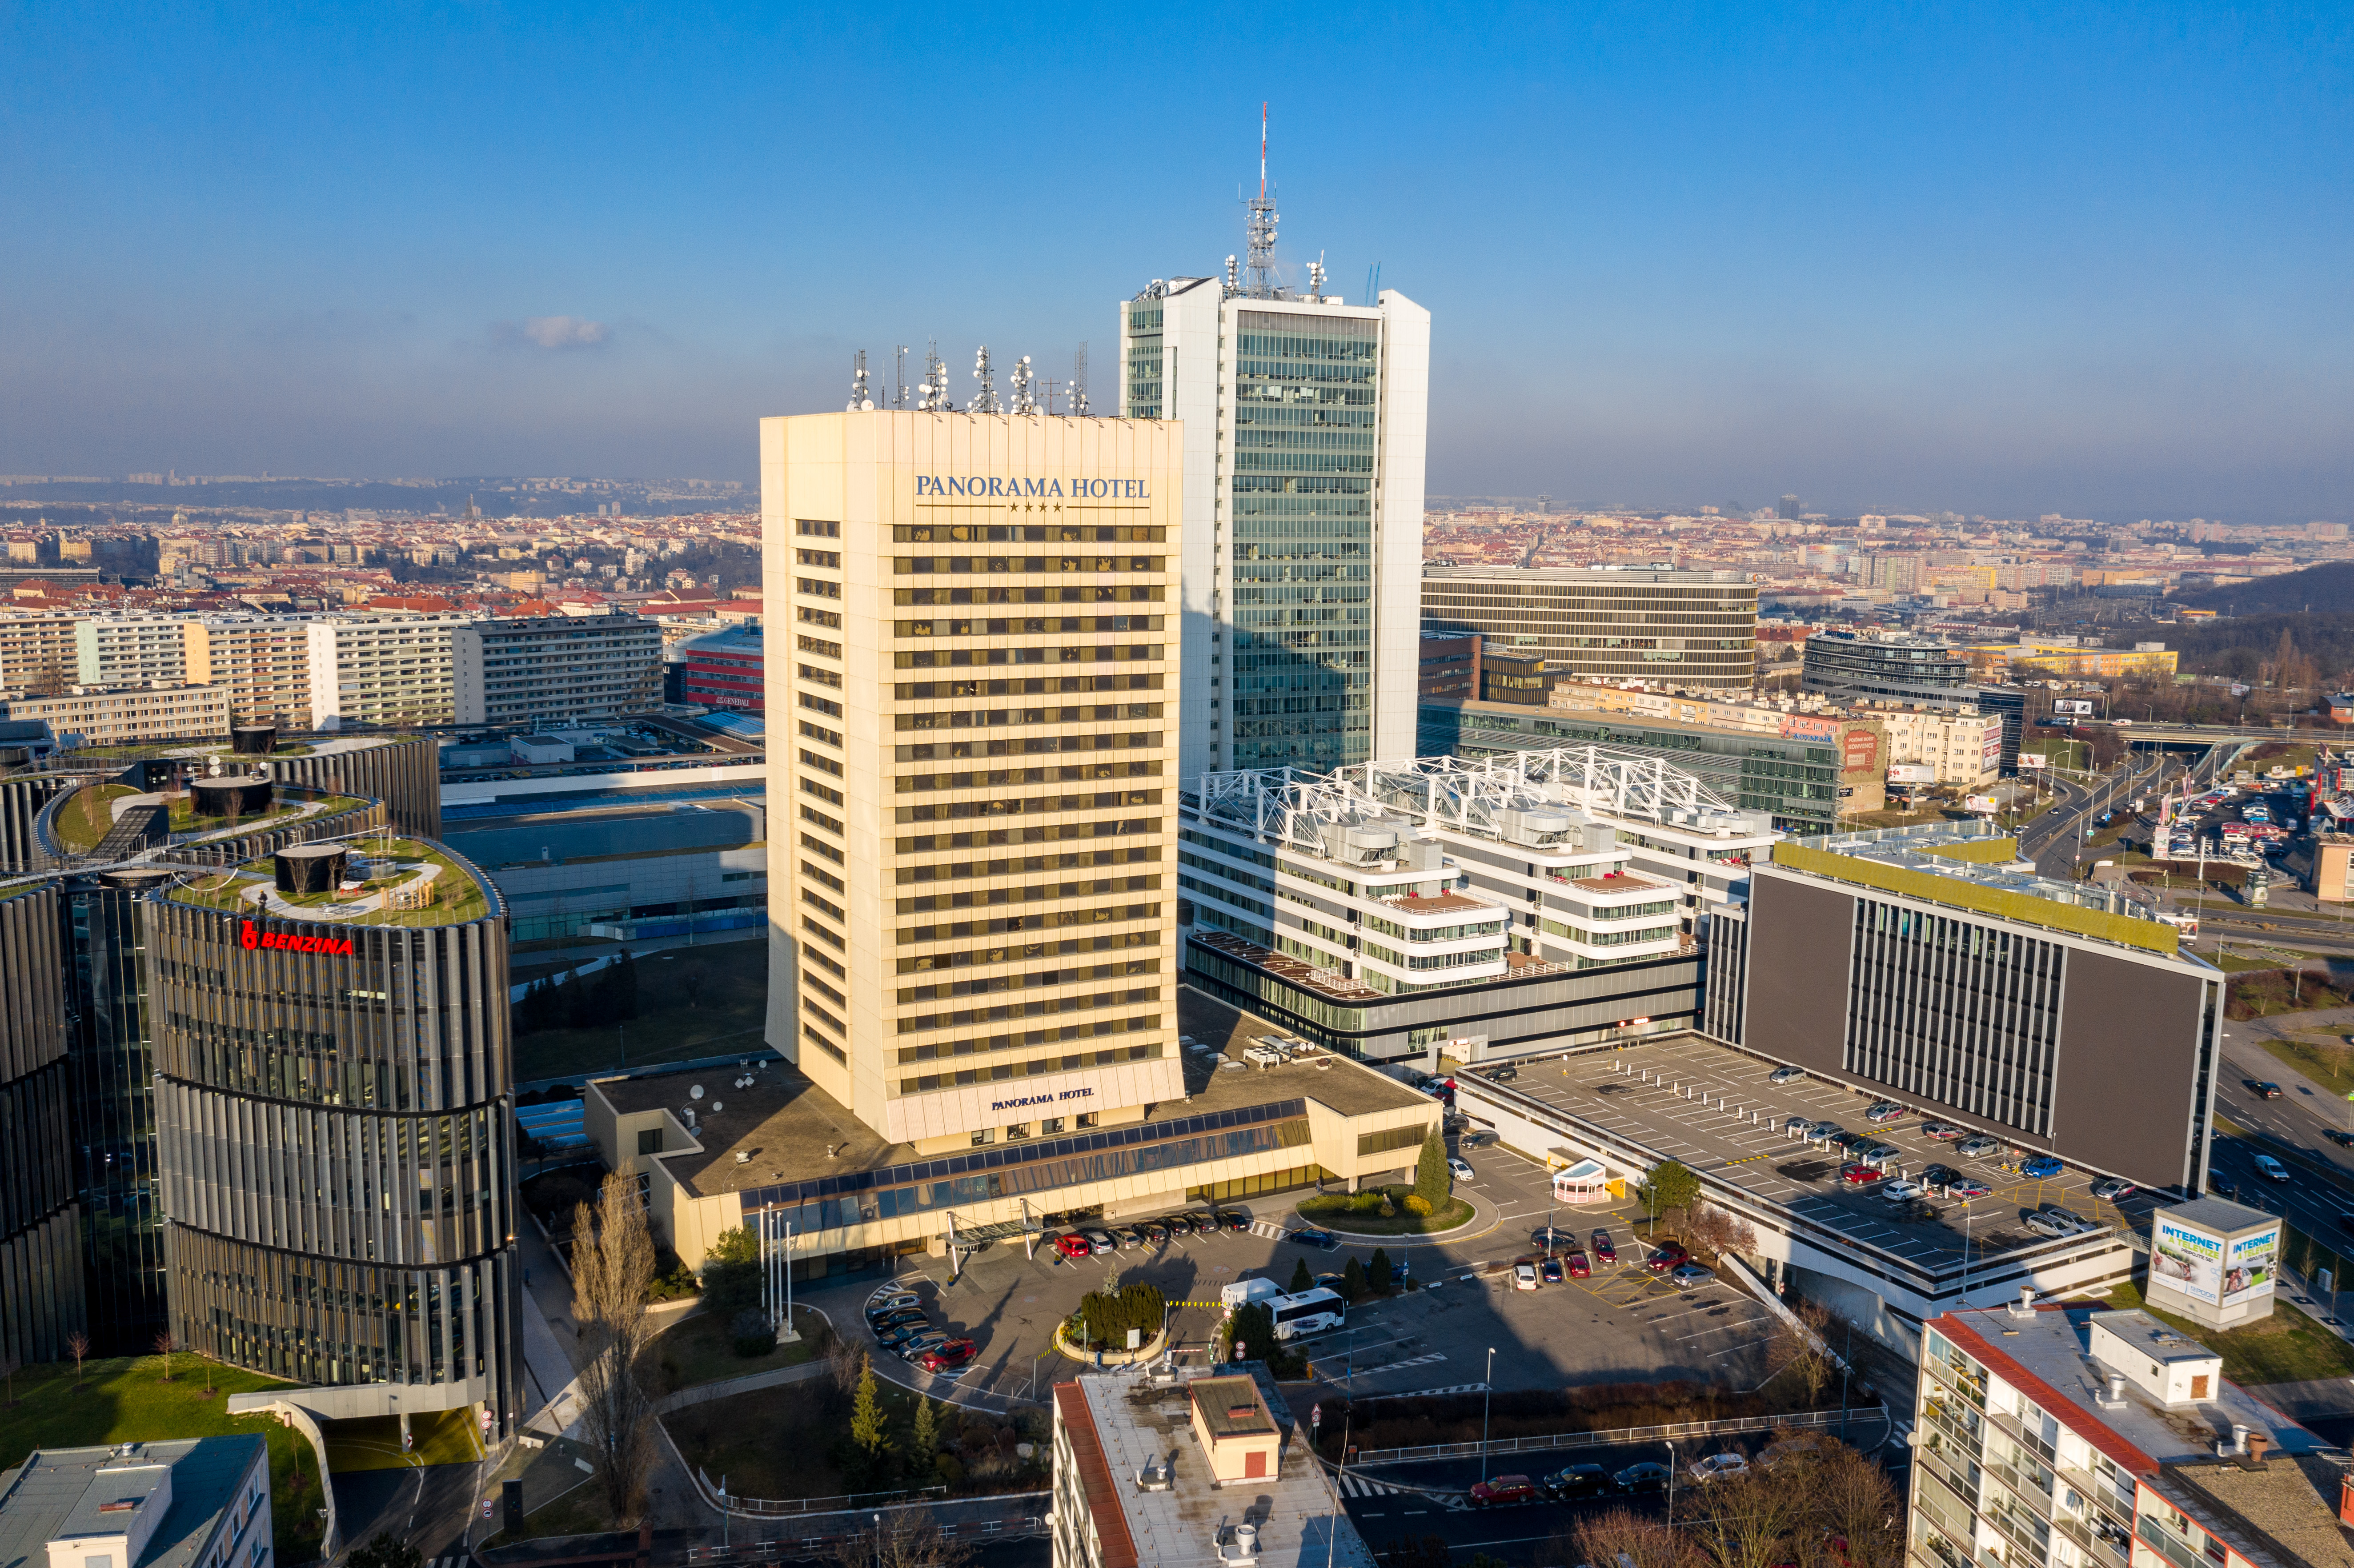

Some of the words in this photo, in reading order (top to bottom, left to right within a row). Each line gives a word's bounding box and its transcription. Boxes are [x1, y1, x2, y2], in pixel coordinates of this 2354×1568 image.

[916, 476, 1064, 497] PANORAMA
[1071, 478, 1150, 498] HOTEL
[724, 697, 749, 706] GENERALI
[1984, 727, 2001, 739] BAUHAUS
[261, 933, 353, 955] BENZINA
[992, 1094, 1054, 1111] PANORAMA
[1059, 1088, 1094, 1100] HOTEL
[2162, 1225, 2222, 1251] INTERNET
[2168, 1236, 2175, 1244] A
[2177, 1238, 2219, 1259] TELEVIZE
[2233, 1232, 2276, 1254] INTERNET
[2181, 1247, 2205, 1259] PŘIPOJTE
[2244, 1242, 2274, 1258] TELEVIZE
[2196, 1288, 2216, 1300] PODA
